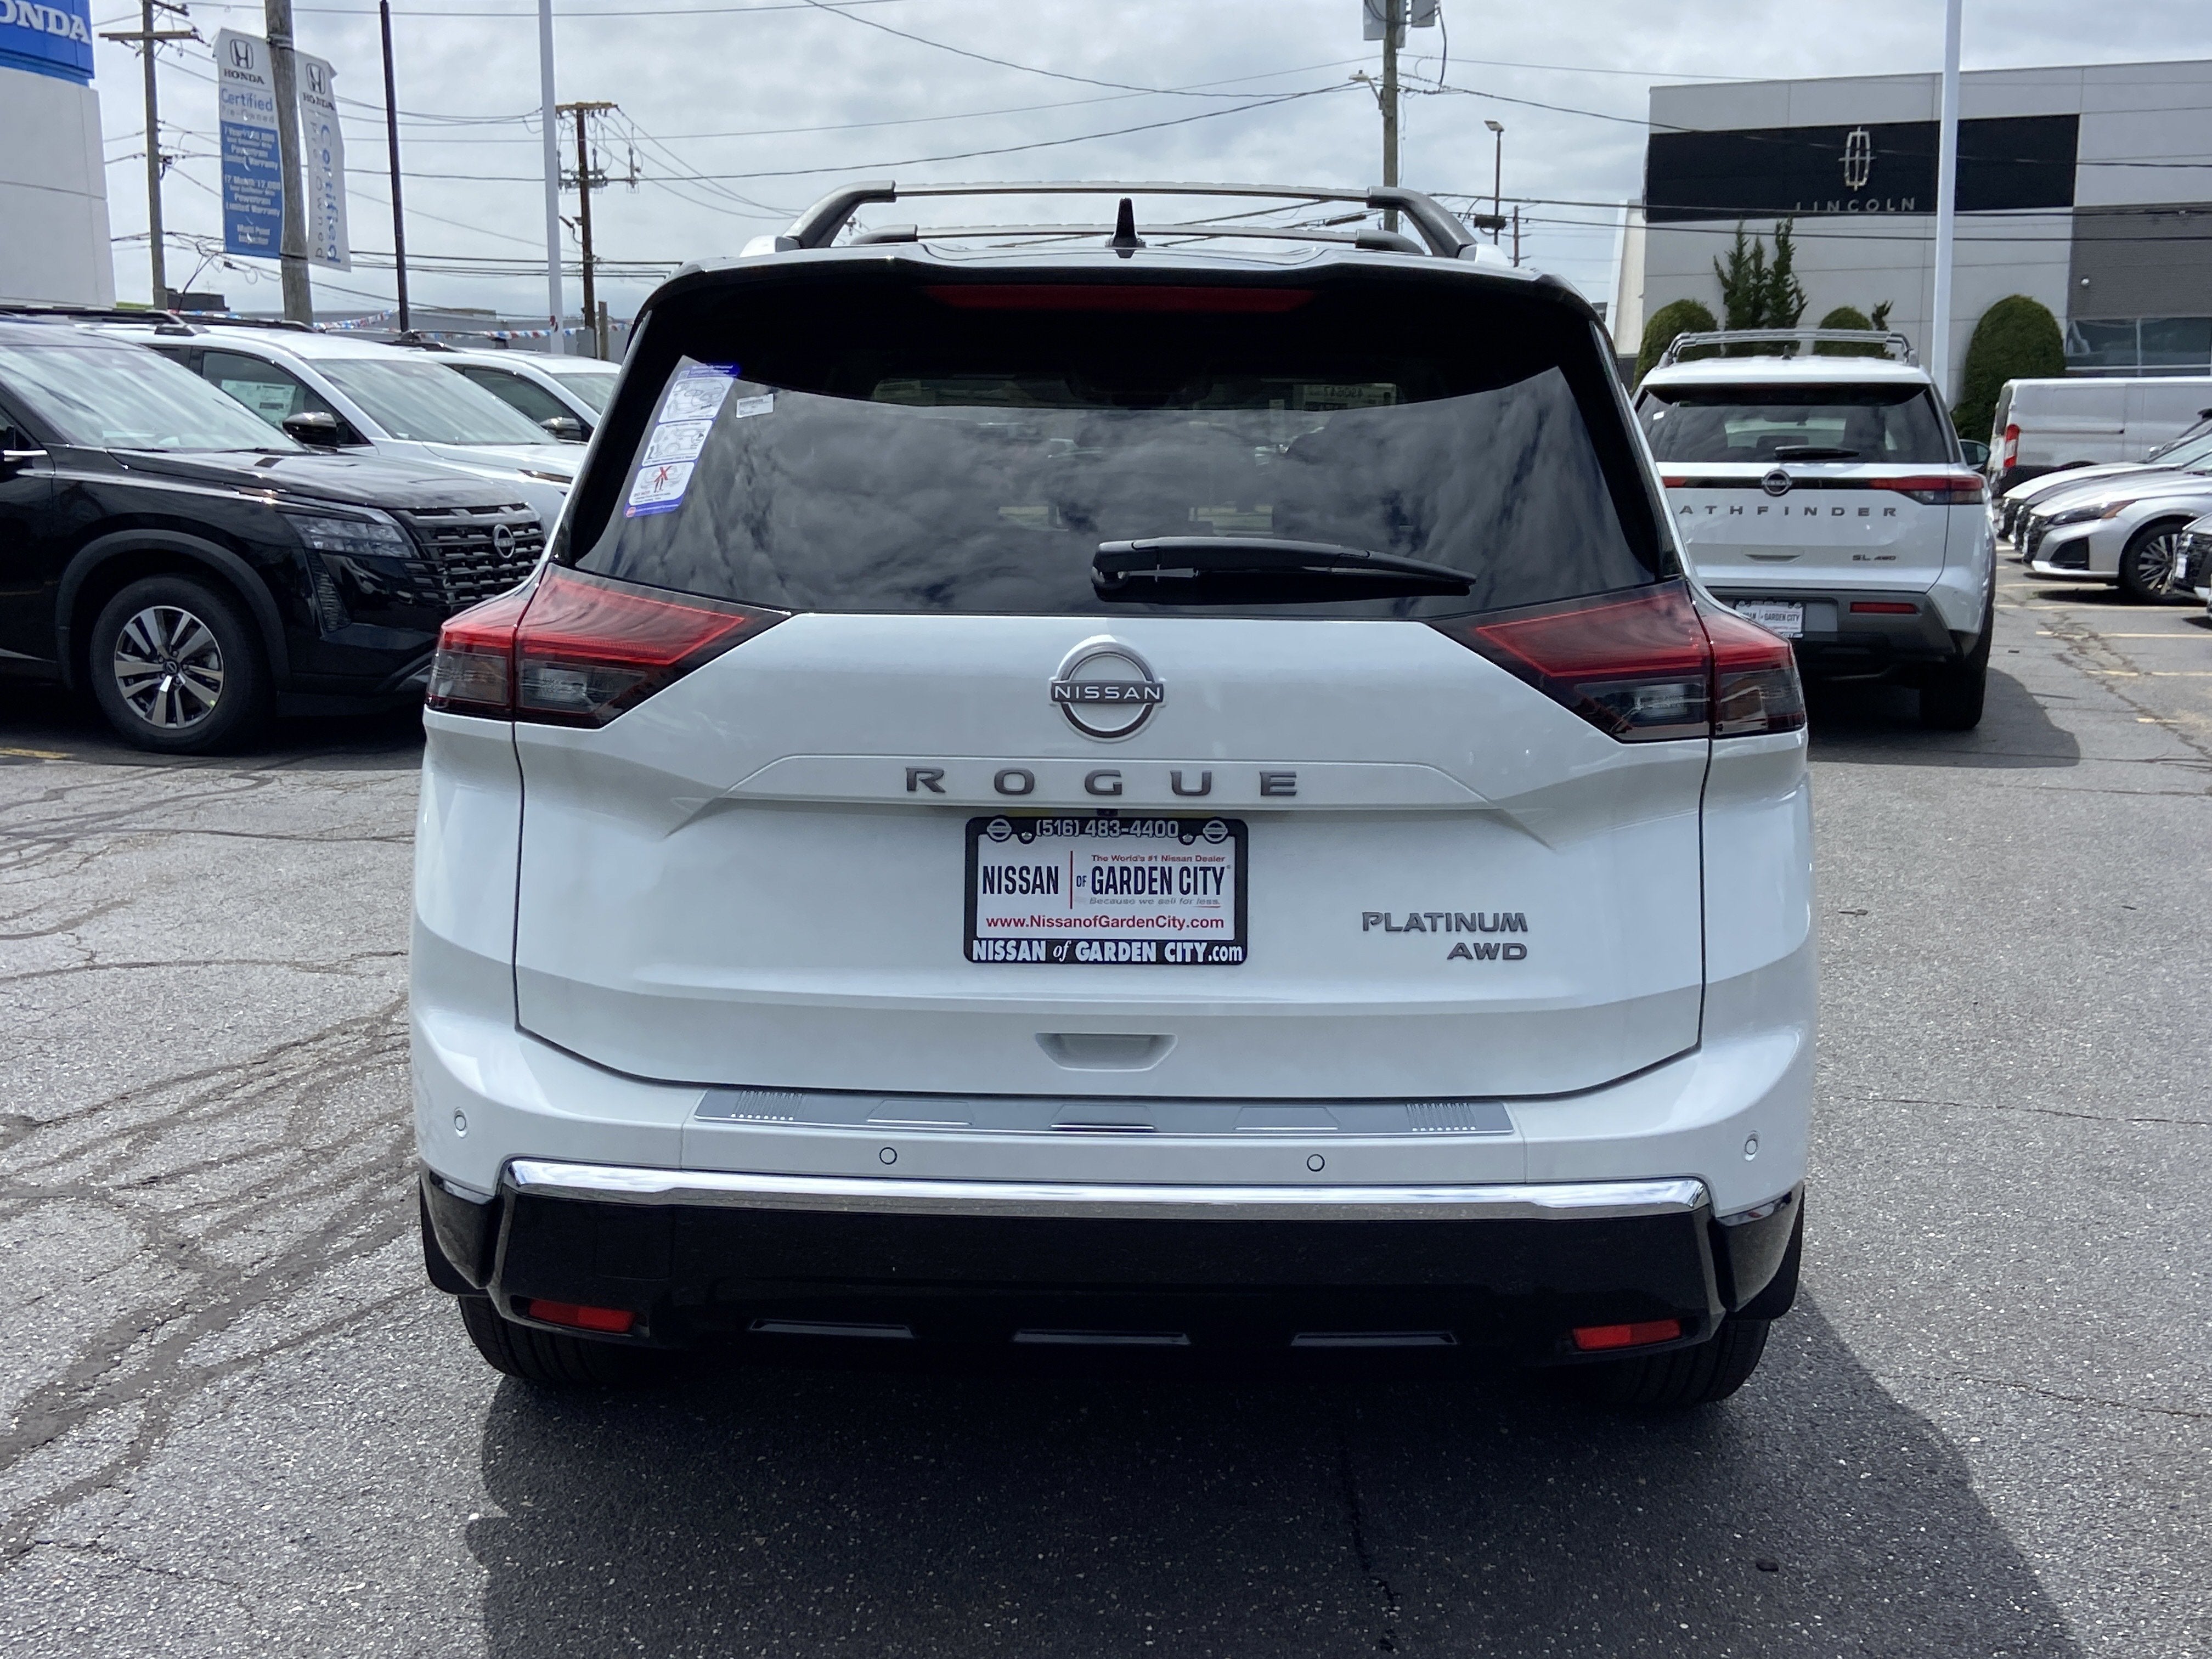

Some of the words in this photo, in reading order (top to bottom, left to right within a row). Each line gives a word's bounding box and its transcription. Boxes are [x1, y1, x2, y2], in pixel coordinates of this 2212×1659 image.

[224, 69, 265, 84] HONDA
[221, 88, 273, 112] Certified
[1054, 686, 1160, 700] NISSAN
[905, 766, 1298, 797] ROGUE
[1036, 820, 1080, 837] (516)
[1085, 820, 1180, 838] 483-4400
[1111, 854, 1146, 862] World's
[1195, 855, 1226, 863] Dealer
[982, 865, 1059, 895] NISSAN
[1076, 875, 1087, 888] OF
[1091, 865, 1172, 895] GARDEN
[1179, 866, 1225, 896] CITY
[1089, 896, 1136, 905] Because
[986, 915, 1224, 931] www.NissanofGardenCity.com
[1362, 911, 1529, 933] PLATINUM
[972, 940, 1046, 961] NISSAN
[1052, 940, 1073, 962] of
[1075, 941, 1156, 962] GARDEN
[1447, 942, 1528, 960] AWD
